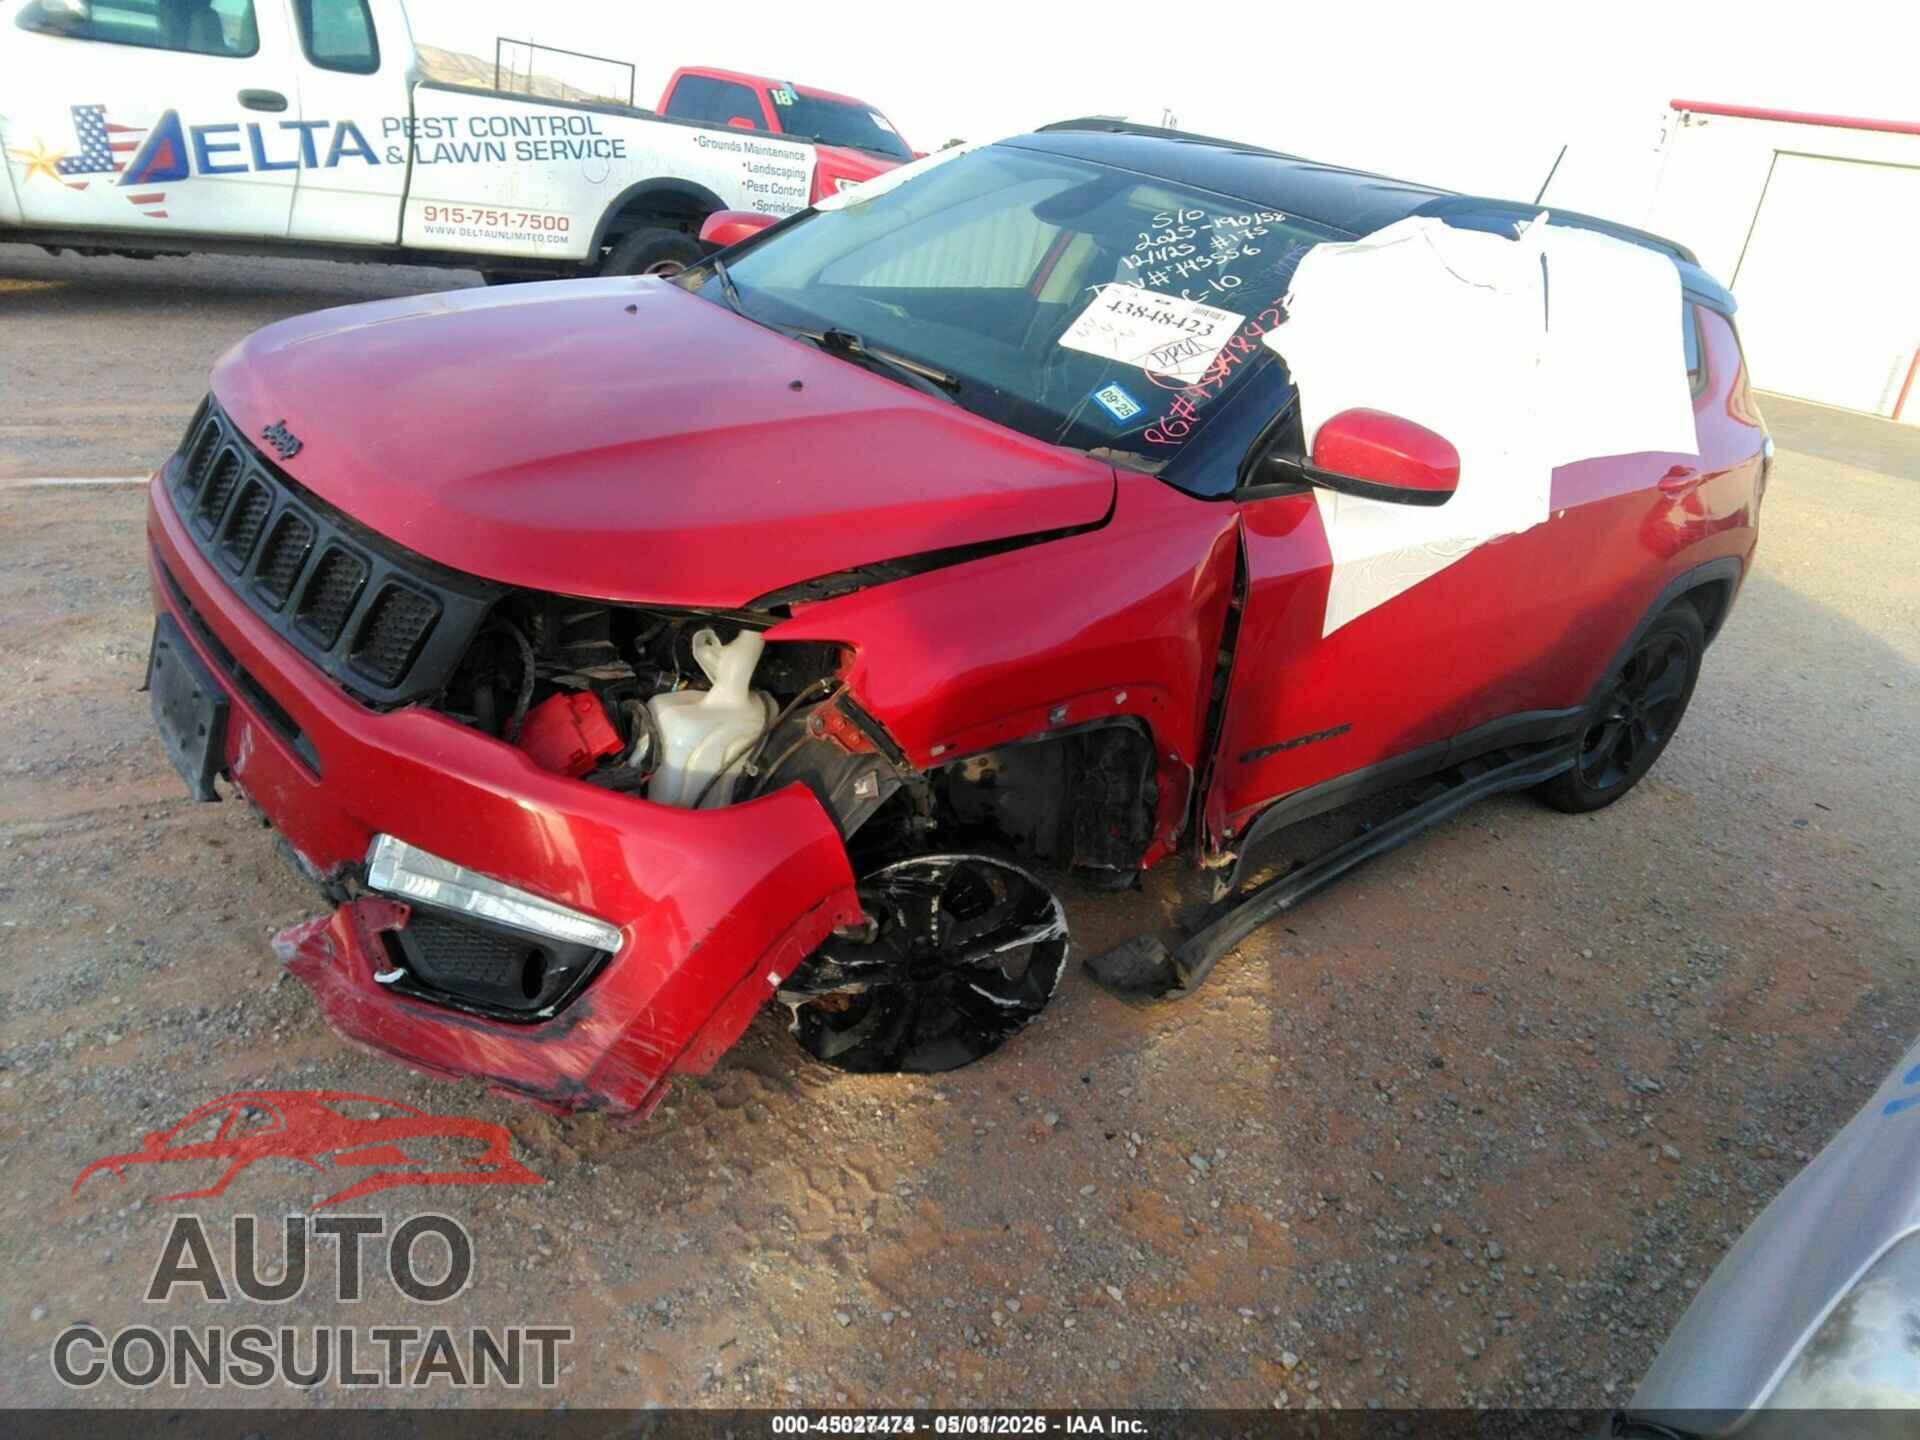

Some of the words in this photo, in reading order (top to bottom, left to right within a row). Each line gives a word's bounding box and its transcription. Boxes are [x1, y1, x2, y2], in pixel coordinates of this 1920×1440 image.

[381, 117, 458, 139] PEST
[469, 116, 603, 138] CONTROL
[386, 146, 405, 164] &
[414, 141, 505, 164] LAWN
[515, 139, 627, 161] SERVICE
[698, 135, 742, 153] Grounds
[744, 142, 806, 160] Maintenance
[747, 161, 806, 182] Landscaping
[747, 180, 769, 193] Pest
[771, 183, 806, 197] Control
[424, 206, 570, 232] 915-751-7500
